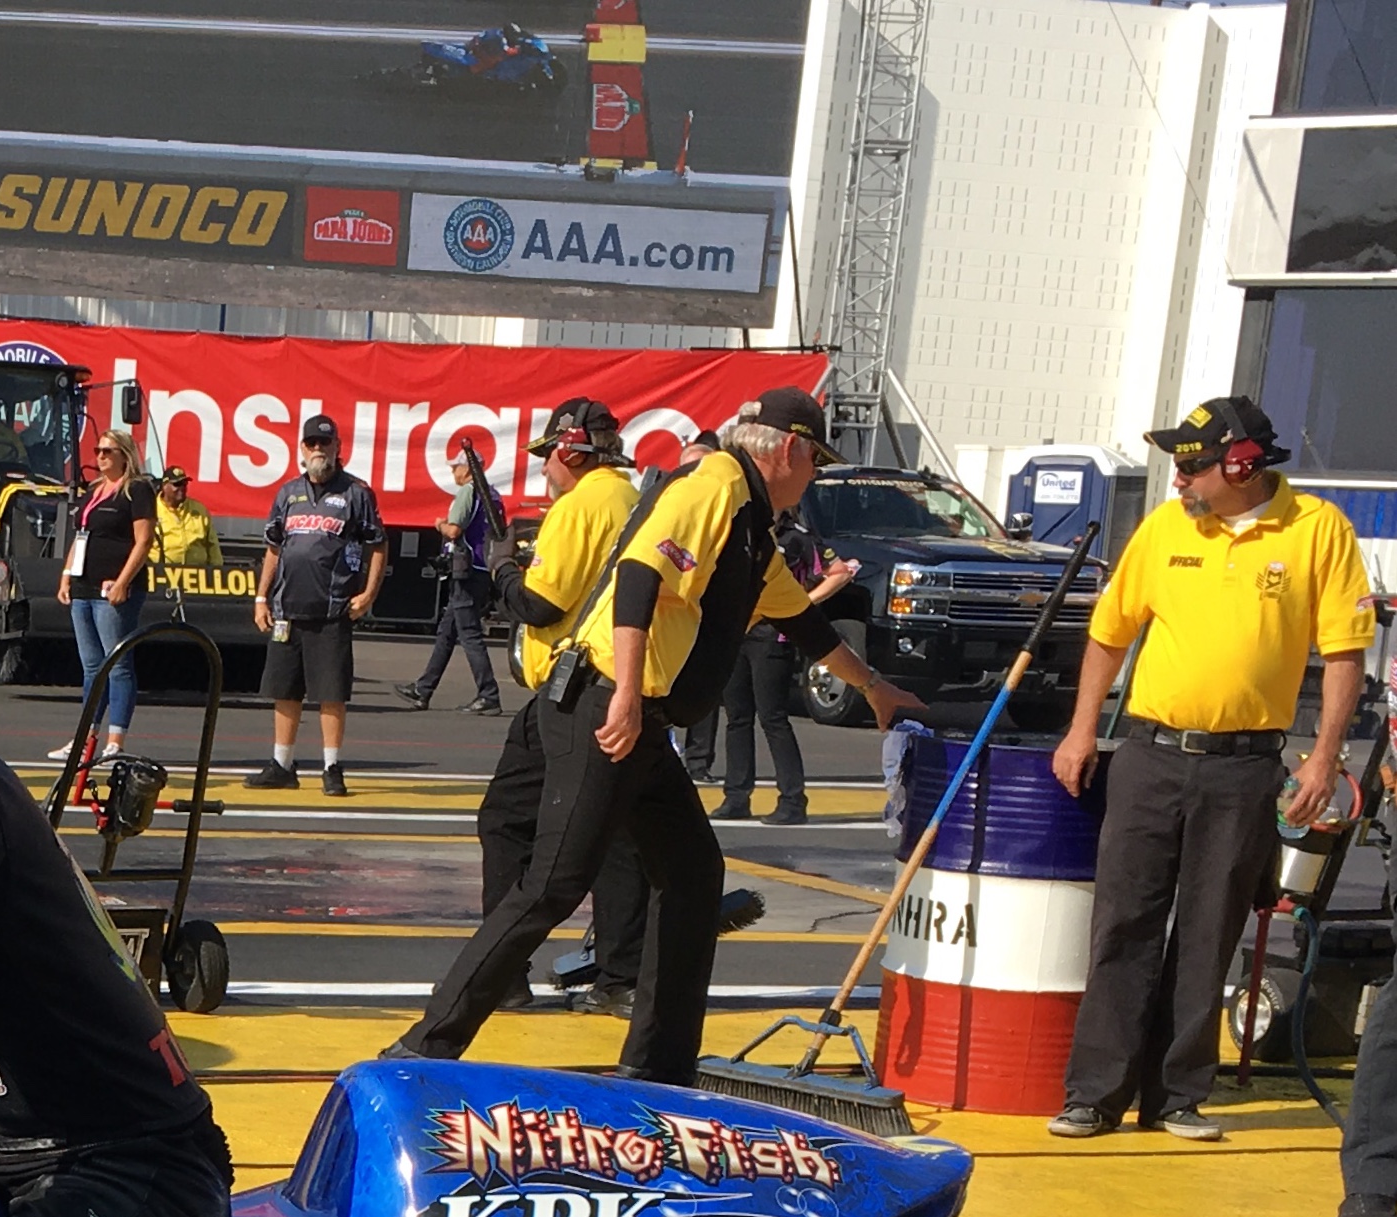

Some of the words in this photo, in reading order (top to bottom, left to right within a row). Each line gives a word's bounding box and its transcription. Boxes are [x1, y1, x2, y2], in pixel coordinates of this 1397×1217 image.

[463, 224, 495, 244] AAA
[520, 218, 735, 274] AAA.com
[1175, 442, 1202, 453] 2018
[320, 516, 345, 536] OIL
[1168, 555, 1205, 569] OFFICIAL
[425, 1096, 664, 1190] Nitro
[647, 1103, 843, 1190] Fish
